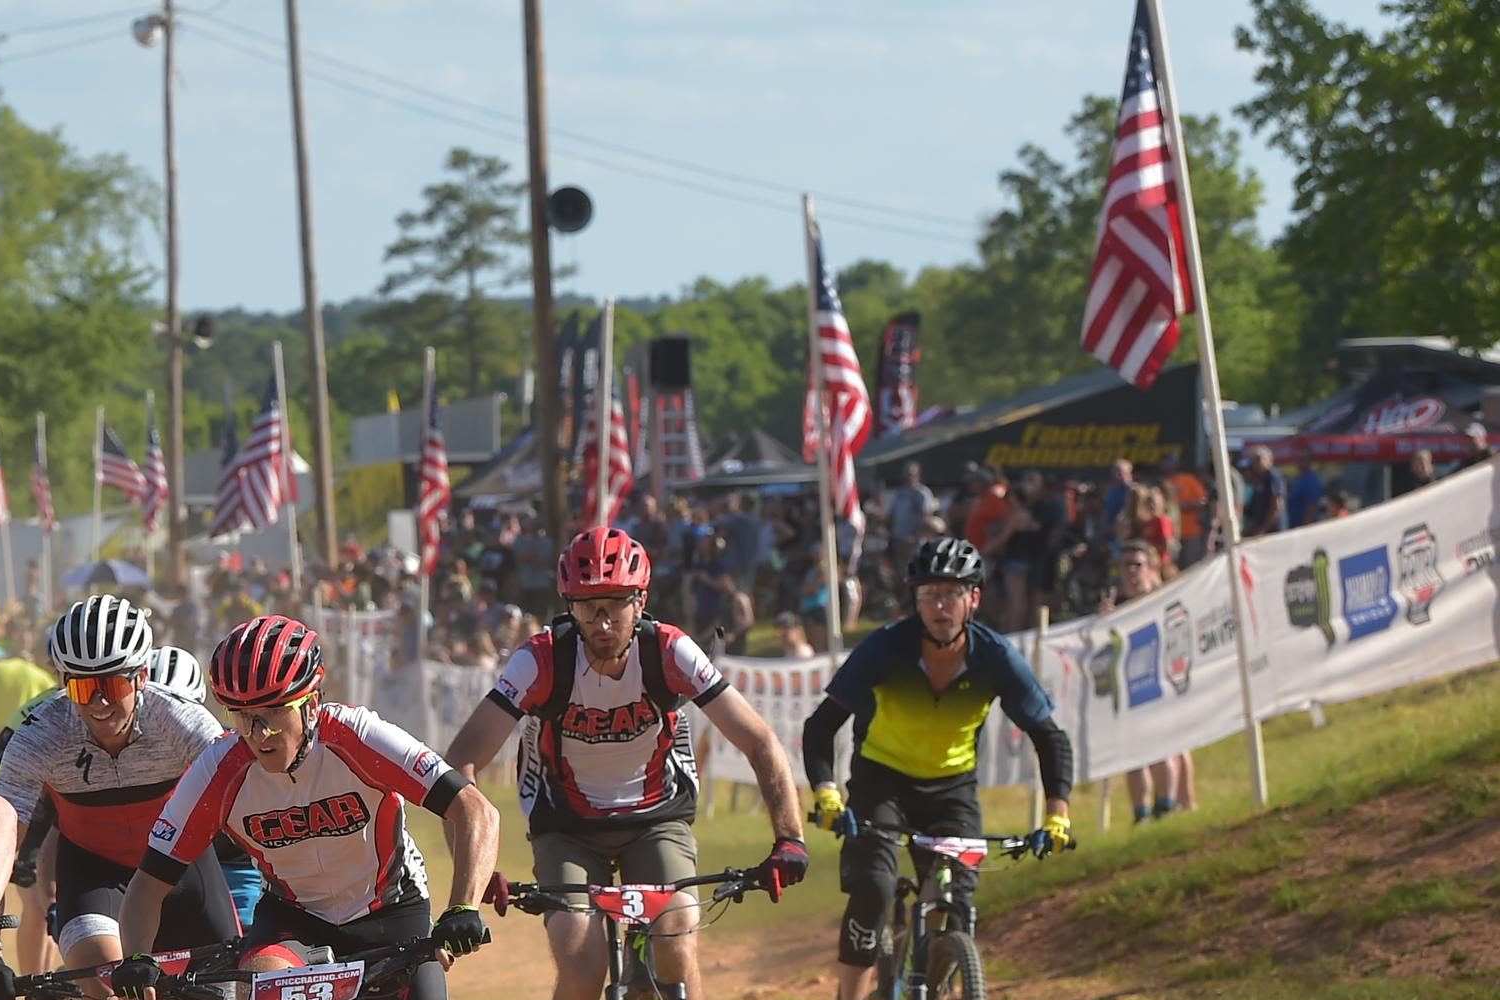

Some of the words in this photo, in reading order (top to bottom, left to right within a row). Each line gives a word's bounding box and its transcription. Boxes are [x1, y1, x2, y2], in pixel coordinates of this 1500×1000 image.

[1023, 422, 1161, 446] Factory
[250, 793, 367, 841] GEAR
[621, 890, 645, 918] 3
[275, 970, 360, 987] GNCCRACING.COM
